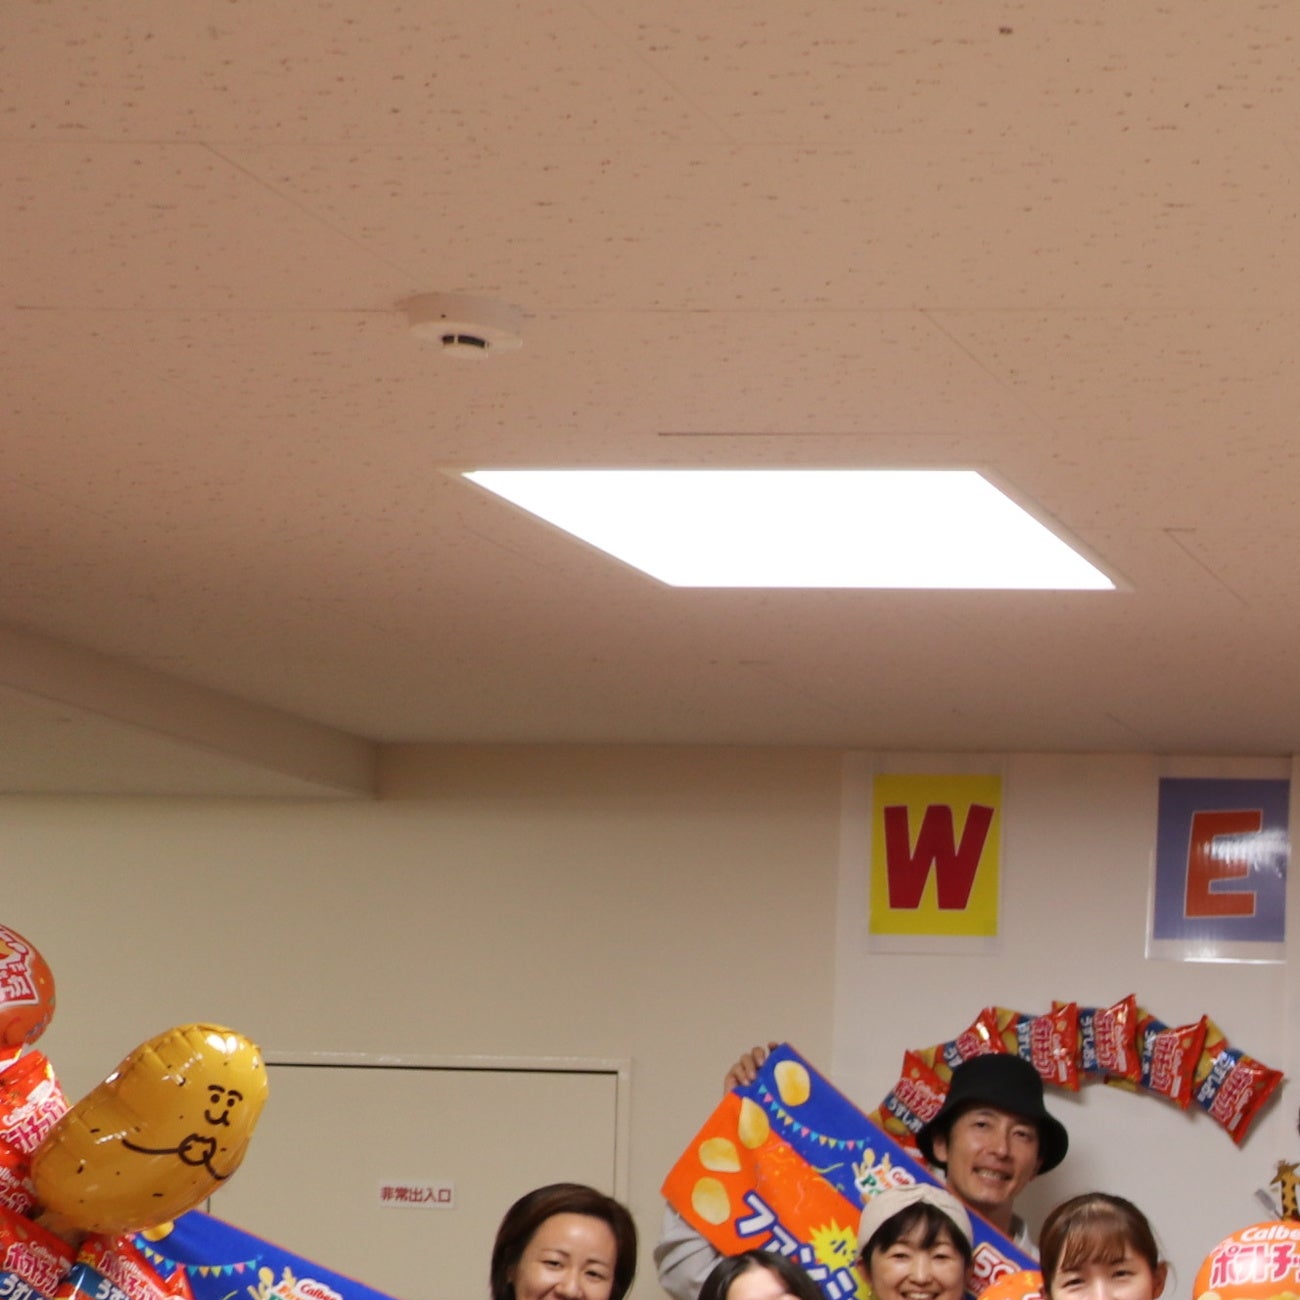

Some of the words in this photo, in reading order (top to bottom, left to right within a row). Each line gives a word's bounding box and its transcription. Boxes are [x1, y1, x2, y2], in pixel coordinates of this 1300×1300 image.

[380, 1186, 452, 1203] 非常出入口
